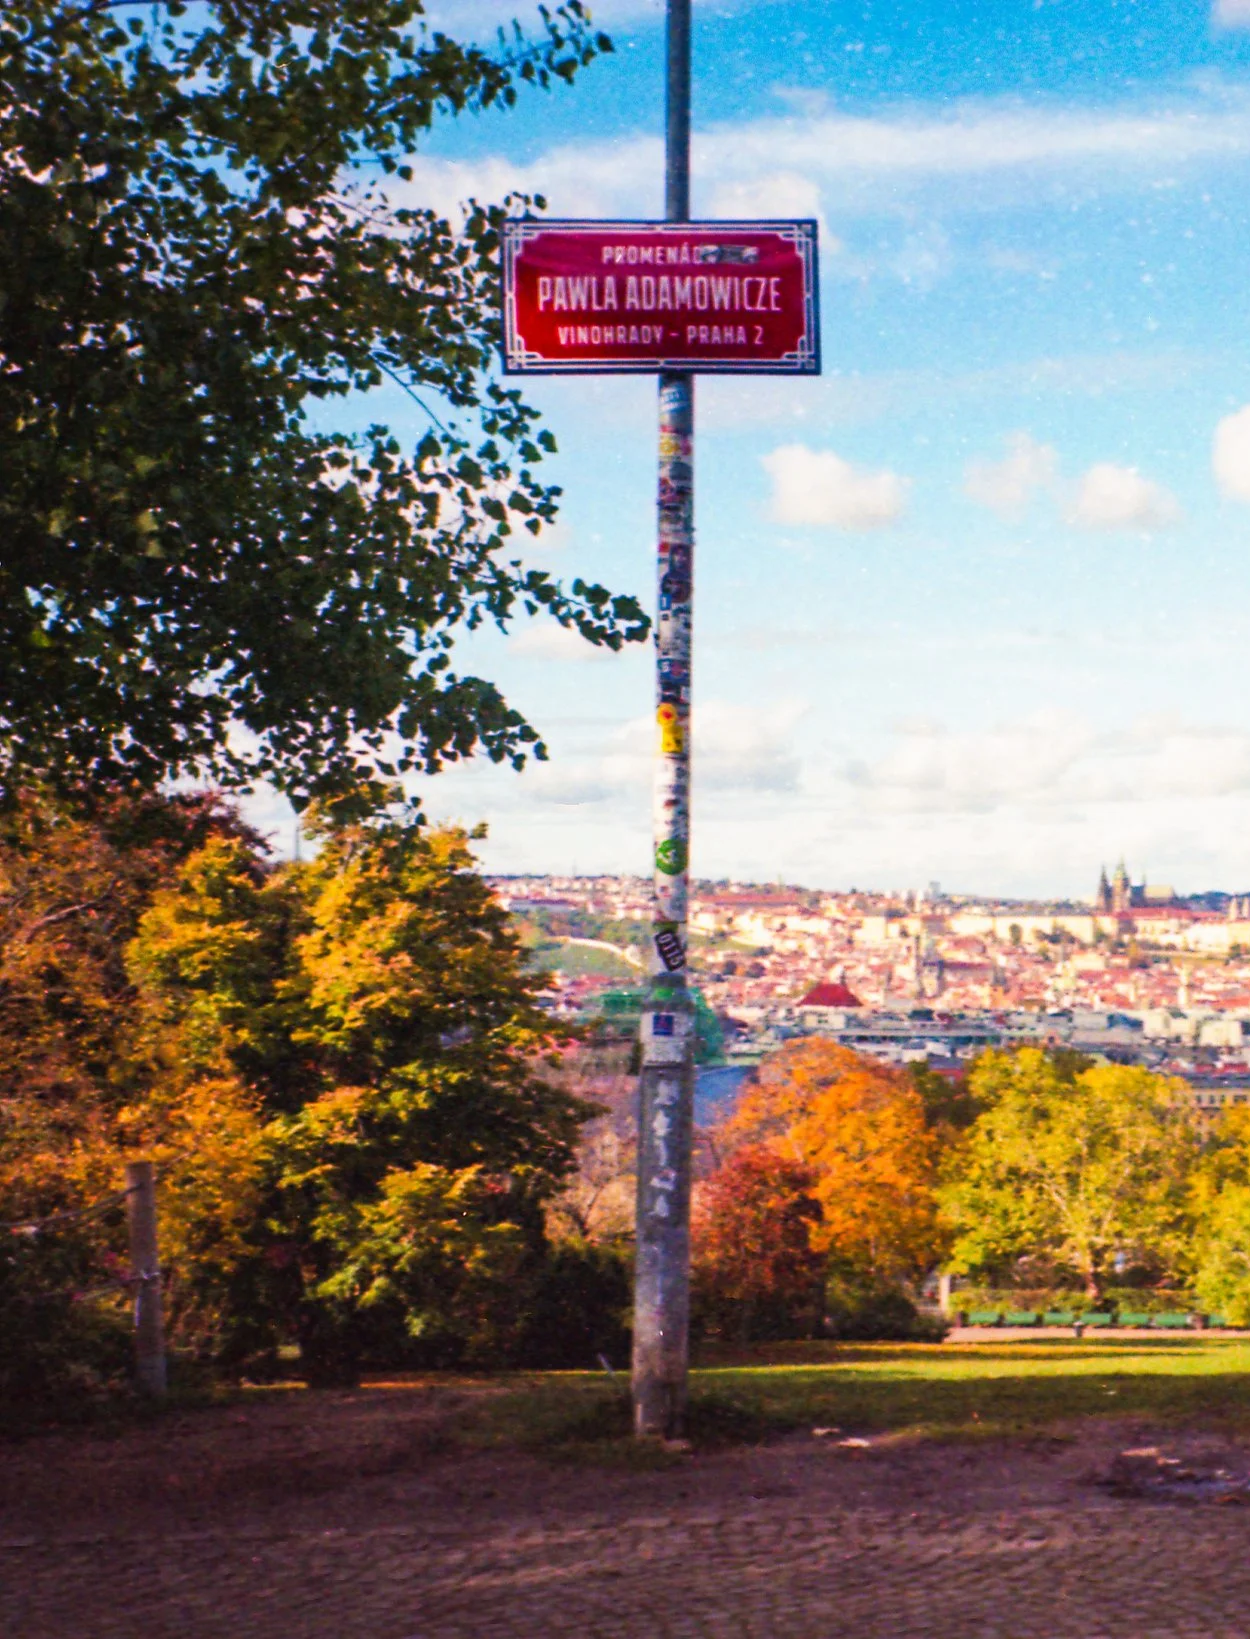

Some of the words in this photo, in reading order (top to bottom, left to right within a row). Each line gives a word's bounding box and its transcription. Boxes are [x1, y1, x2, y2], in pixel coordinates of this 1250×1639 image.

[538, 276, 618, 311] PAWLA
[625, 276, 782, 311] ADAMOWICZE
[558, 325, 664, 345] VINOHRADY
[686, 325, 747, 345] PRAHA
[753, 325, 764, 345] 2
